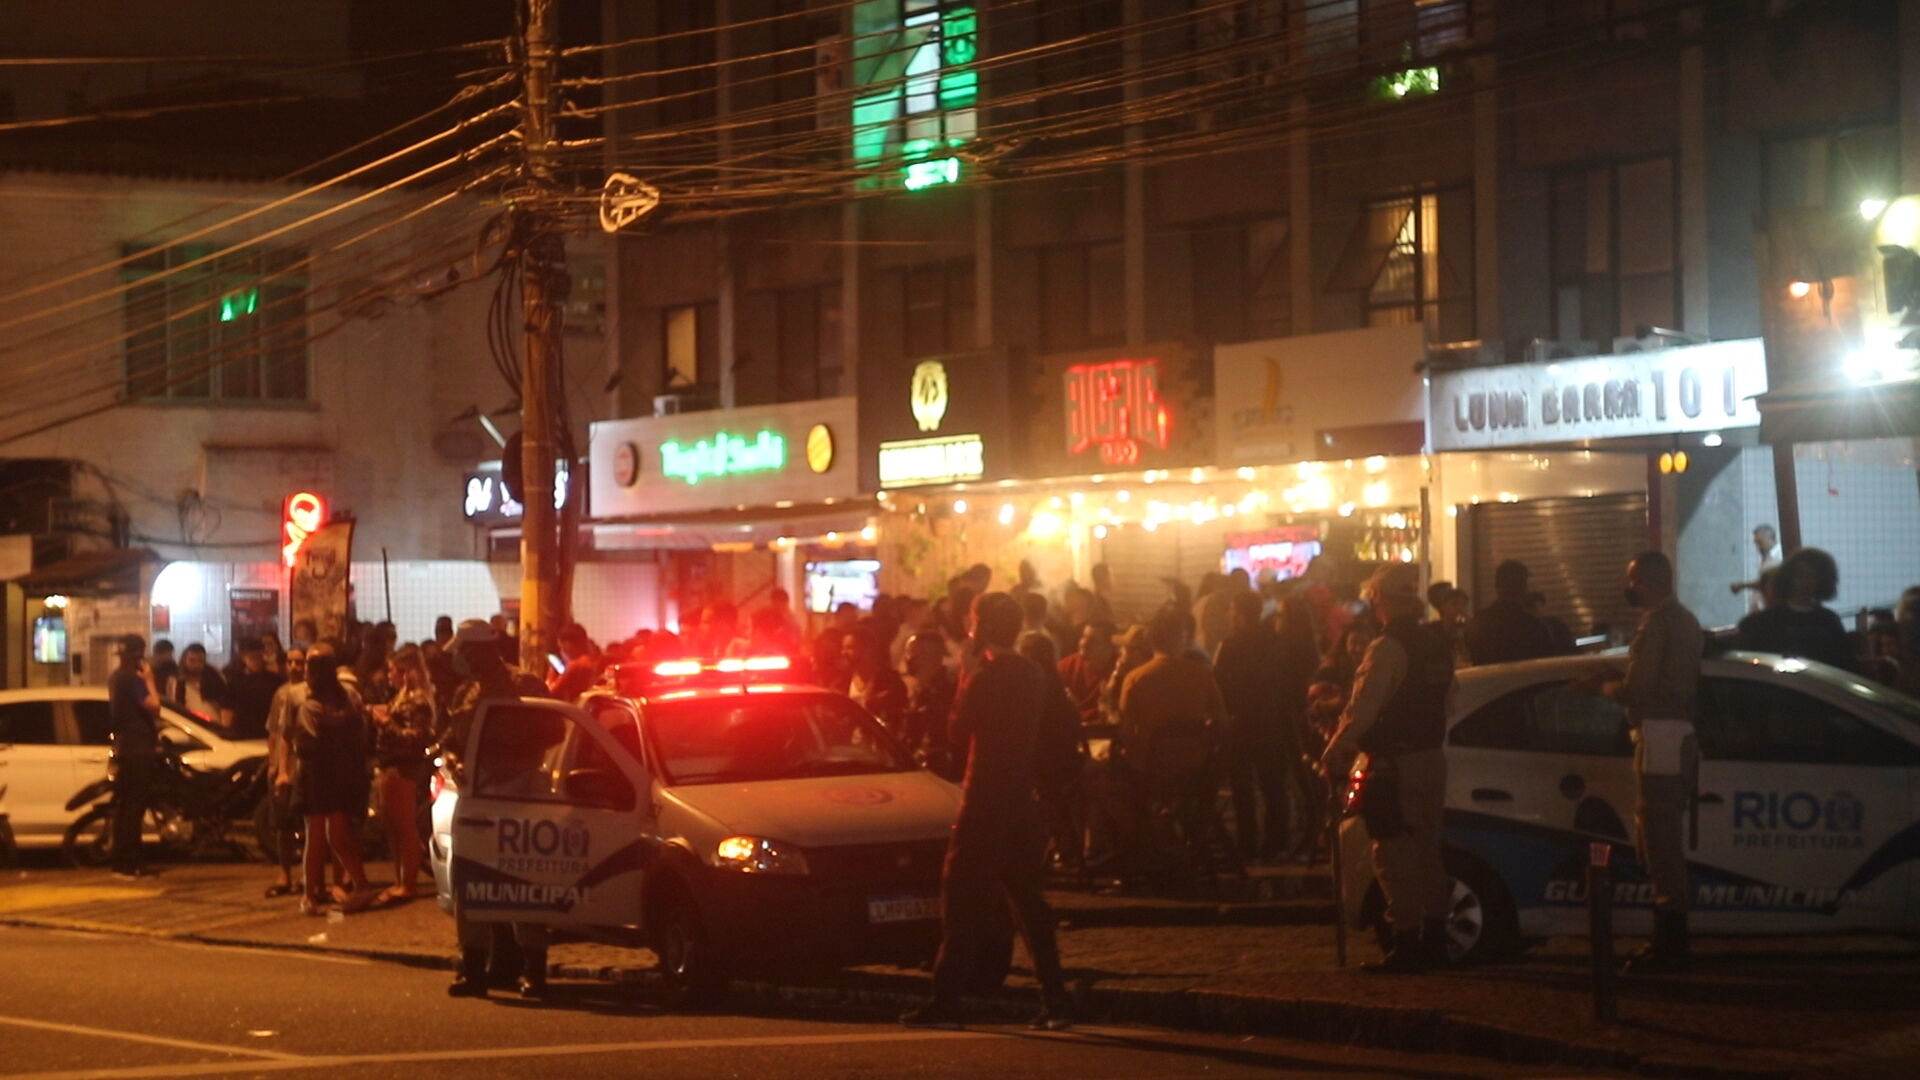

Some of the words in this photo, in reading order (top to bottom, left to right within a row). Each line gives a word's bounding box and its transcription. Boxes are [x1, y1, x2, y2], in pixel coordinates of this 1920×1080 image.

[1454, 390, 1528, 432] LUNA
[1541, 378, 1642, 425] BARRA
[1733, 791, 1820, 831] RIO
[498, 818, 559, 856] RIO
[1733, 833, 1865, 849] PREFEITURA
[498, 857, 589, 874] PREFEITURA
[465, 881, 590, 905] MUNICIPAL
